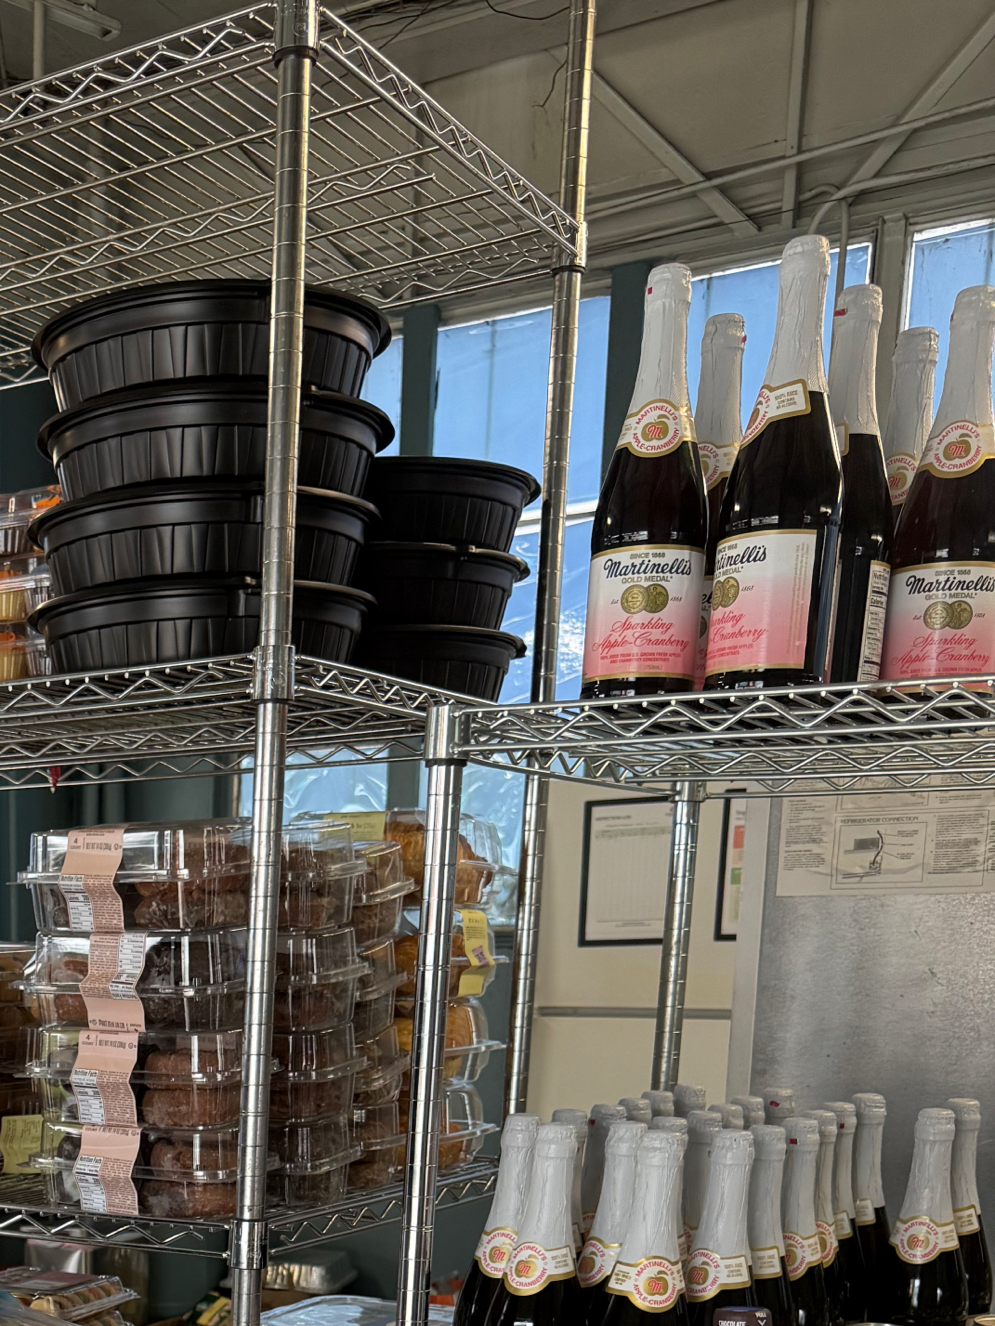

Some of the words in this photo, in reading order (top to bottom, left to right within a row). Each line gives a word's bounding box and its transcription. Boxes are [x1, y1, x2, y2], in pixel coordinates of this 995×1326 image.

[629, 552, 650, 560] SINCE
[622, 575, 643, 583] GOLD
[924, 592, 948, 600] GOLD
[611, 616, 675, 633] Sparkling
[592, 632, 690, 656] Apple-Cranberry
[912, 634, 977, 649] Sparkling
[891, 649, 991, 666] Apple-Cranberry
[882, 815, 919, 823] CONNECTION
[635, 1262, 675, 1278] MARTINELLI'S
[633, 1282, 677, 1307] APPLE-CRANBERRY
